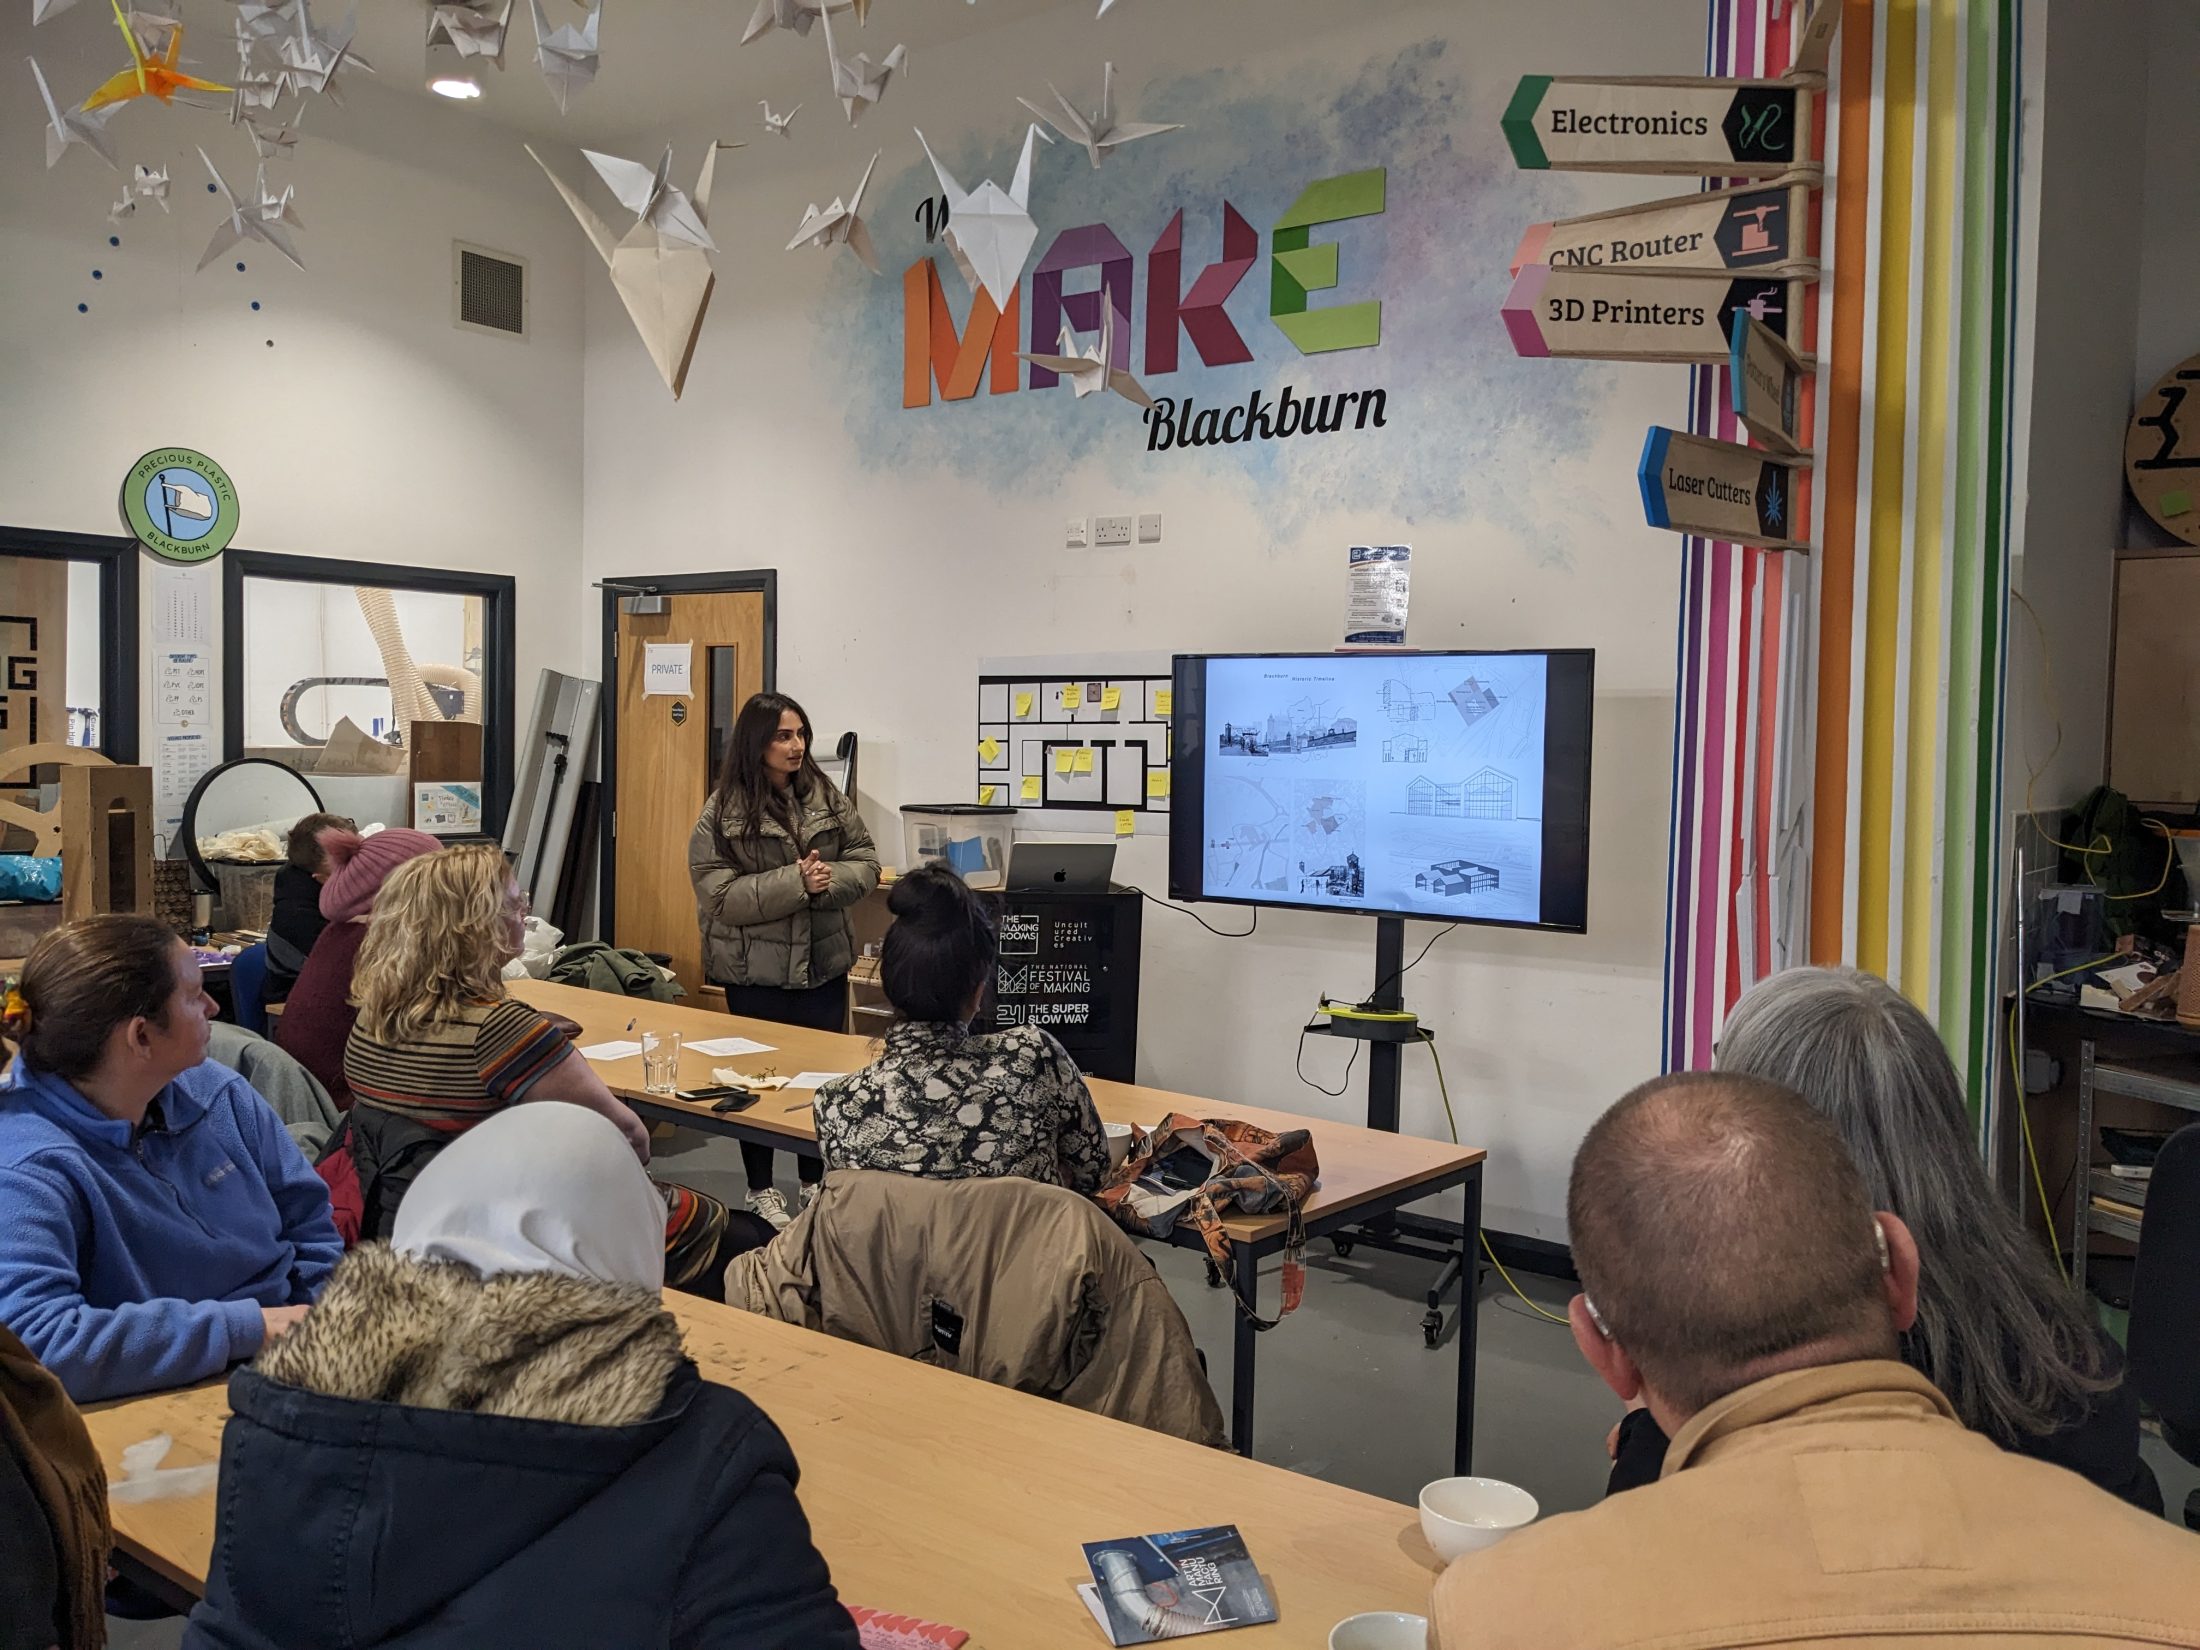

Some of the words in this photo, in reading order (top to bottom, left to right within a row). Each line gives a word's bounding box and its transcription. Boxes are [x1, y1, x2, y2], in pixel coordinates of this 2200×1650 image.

[1551, 110, 1708, 135] Electronics
[1550, 244, 1603, 266] CNC
[1609, 232, 1703, 264] Router
[903, 167, 1386, 409] MAKE
[1549, 298, 1585, 322] 3D
[1591, 299, 1704, 326] Printers
[1143, 385, 1388, 452] Blackburn
[138, 454, 193, 479] PRECIOUS
[196, 460, 231, 501] PLASTIC
[1668, 467, 1704, 495] Laser
[1707, 477, 1751, 506] Cutters
[147, 531, 211, 554] BLACKBURN
[651, 664, 683, 675] PRIVATE
[1001, 923, 1039, 932] MAKING
[1002, 915, 1020, 924] THE
[1000, 932, 1036, 940] ROOMS
[1029, 970, 1091, 982] FESTIVAL
[1043, 982, 1091, 993] MAKING
[1028, 1004, 1050, 1014] THE
[1051, 1003, 1090, 1014] SUPER
[1028, 1014, 1062, 1025] SLOW
[1063, 1014, 1089, 1024] WAY
[1179, 1558, 1191, 1569] IN
[1187, 1557, 1206, 1587] MANU
[1195, 1556, 1215, 1586] FACTU
[1207, 1562, 1224, 1584] RING
[1183, 1570, 1198, 1587] ART
